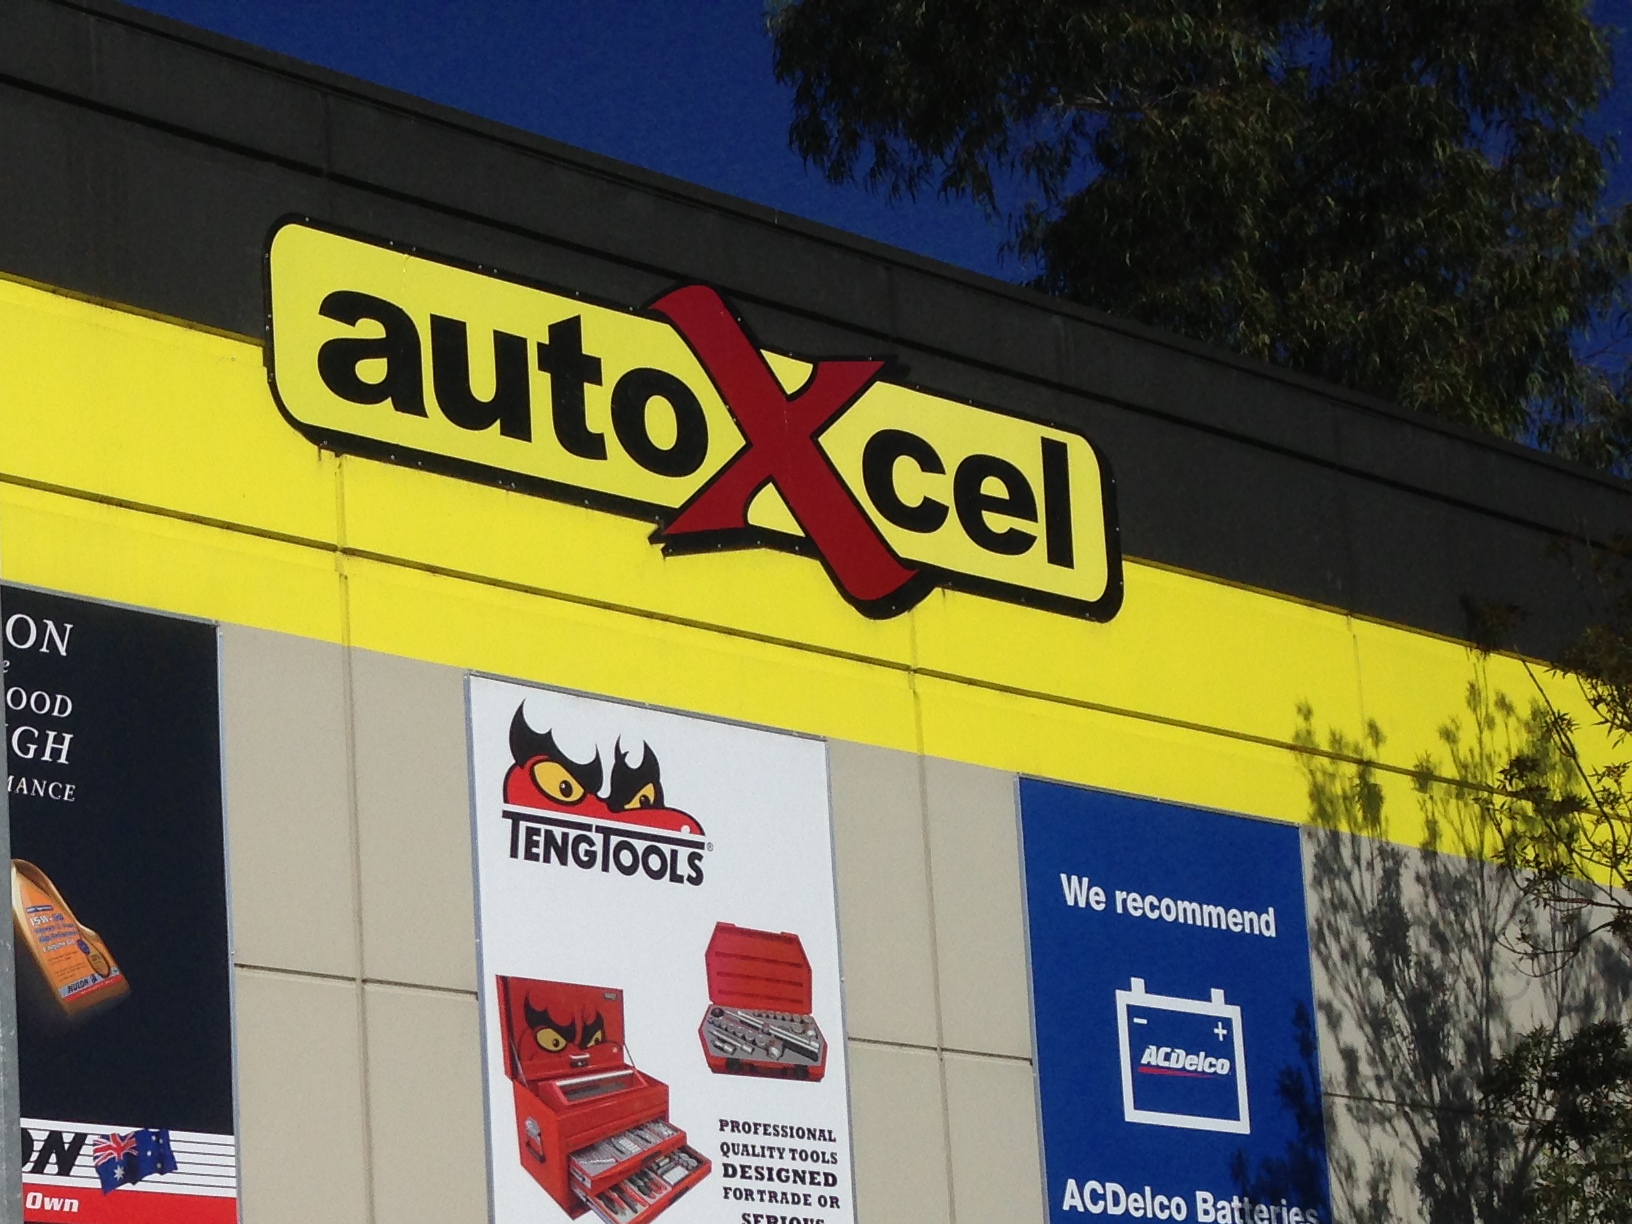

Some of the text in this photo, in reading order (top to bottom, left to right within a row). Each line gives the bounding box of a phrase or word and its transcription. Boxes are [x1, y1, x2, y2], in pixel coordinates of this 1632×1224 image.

[316, 283, 1075, 602] autoXcel
[1060, 873, 1277, 938] We recommend
[1141, 1045, 1230, 1074] ACDelco
[719, 1119, 837, 1142] PROFESSIONAL
[720, 1142, 838, 1165] QUALITY TOOLS
[722, 1163, 838, 1187] DESIGNED
[25, 1192, 79, 1213] Own
[723, 1186, 841, 1209] FOR TRADE OR
[1062, 1178, 1188, 1223] ACDelco
